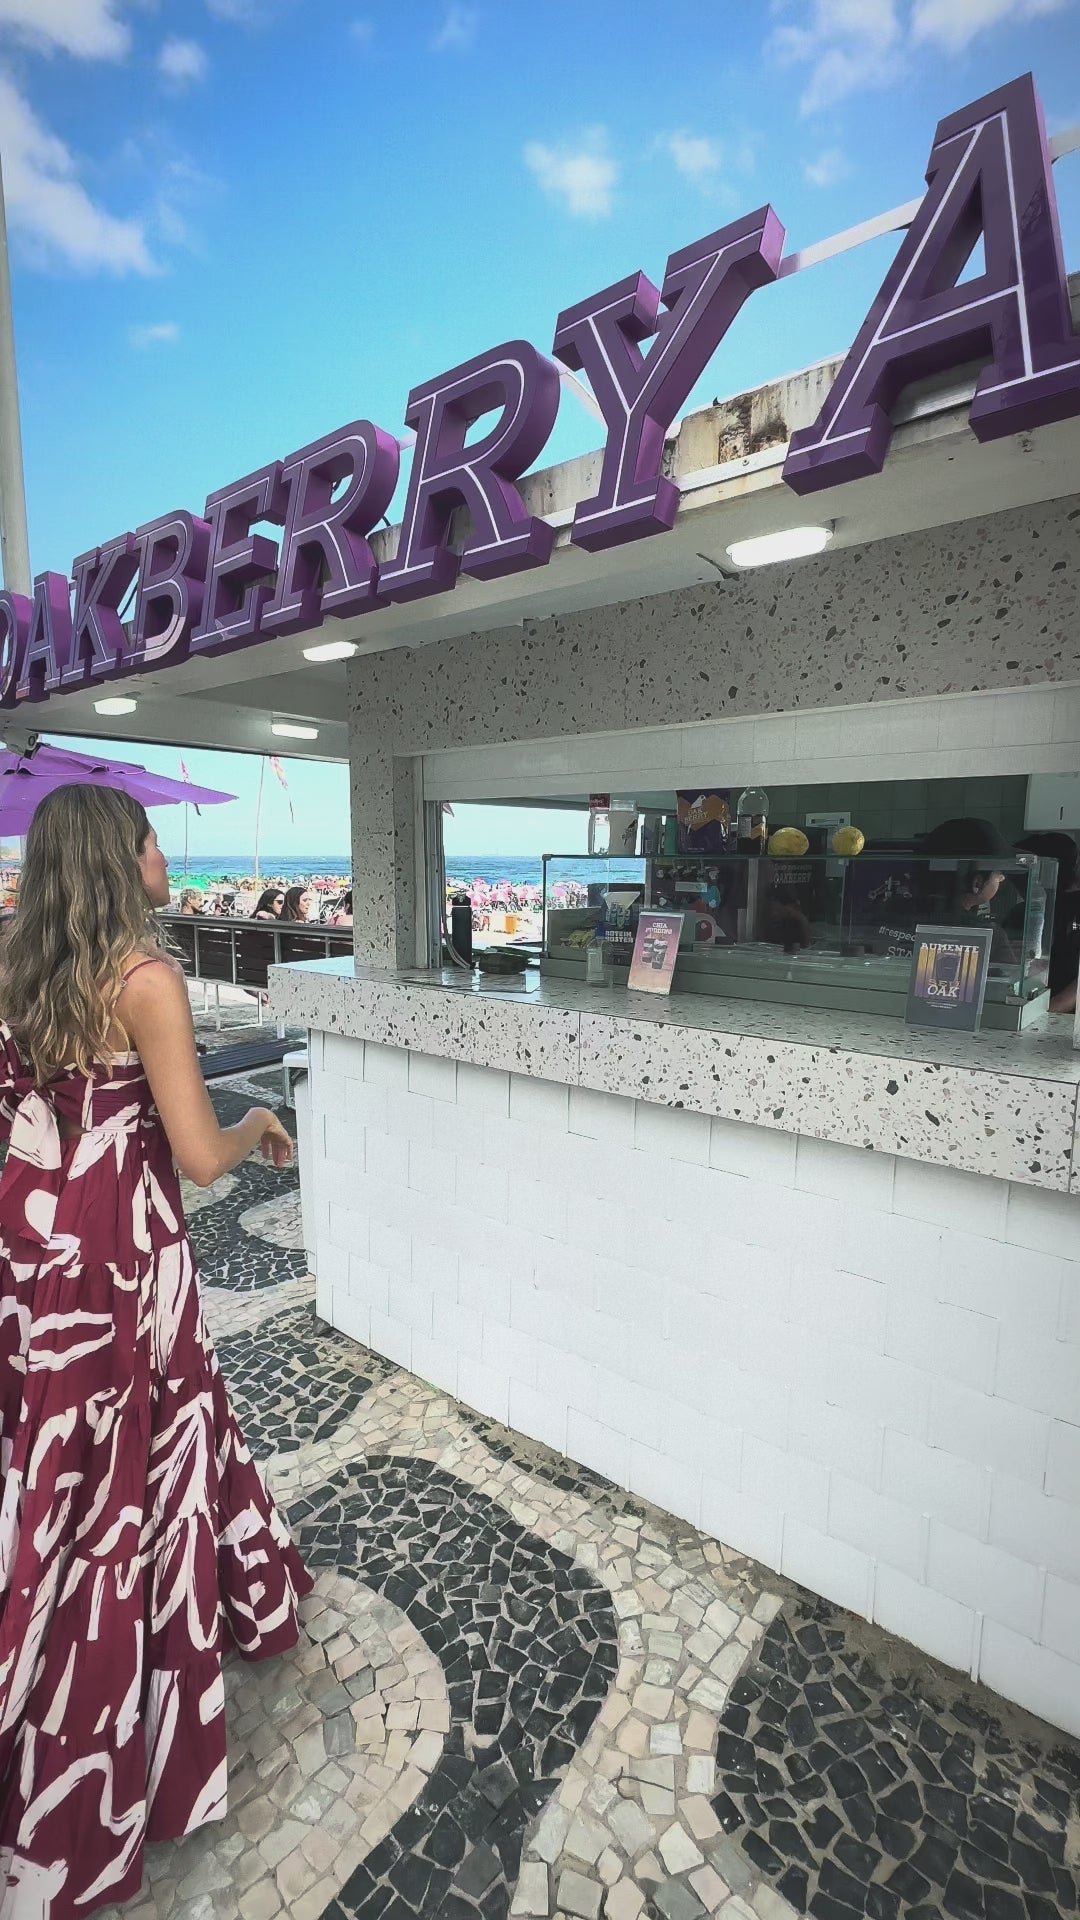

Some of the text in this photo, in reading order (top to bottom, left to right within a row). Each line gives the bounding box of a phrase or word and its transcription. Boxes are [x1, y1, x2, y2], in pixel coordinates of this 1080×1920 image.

[645, 927, 673, 935] PUDDING
[920, 942, 980, 954] AUMENTE
[927, 984, 960, 998] OAK
